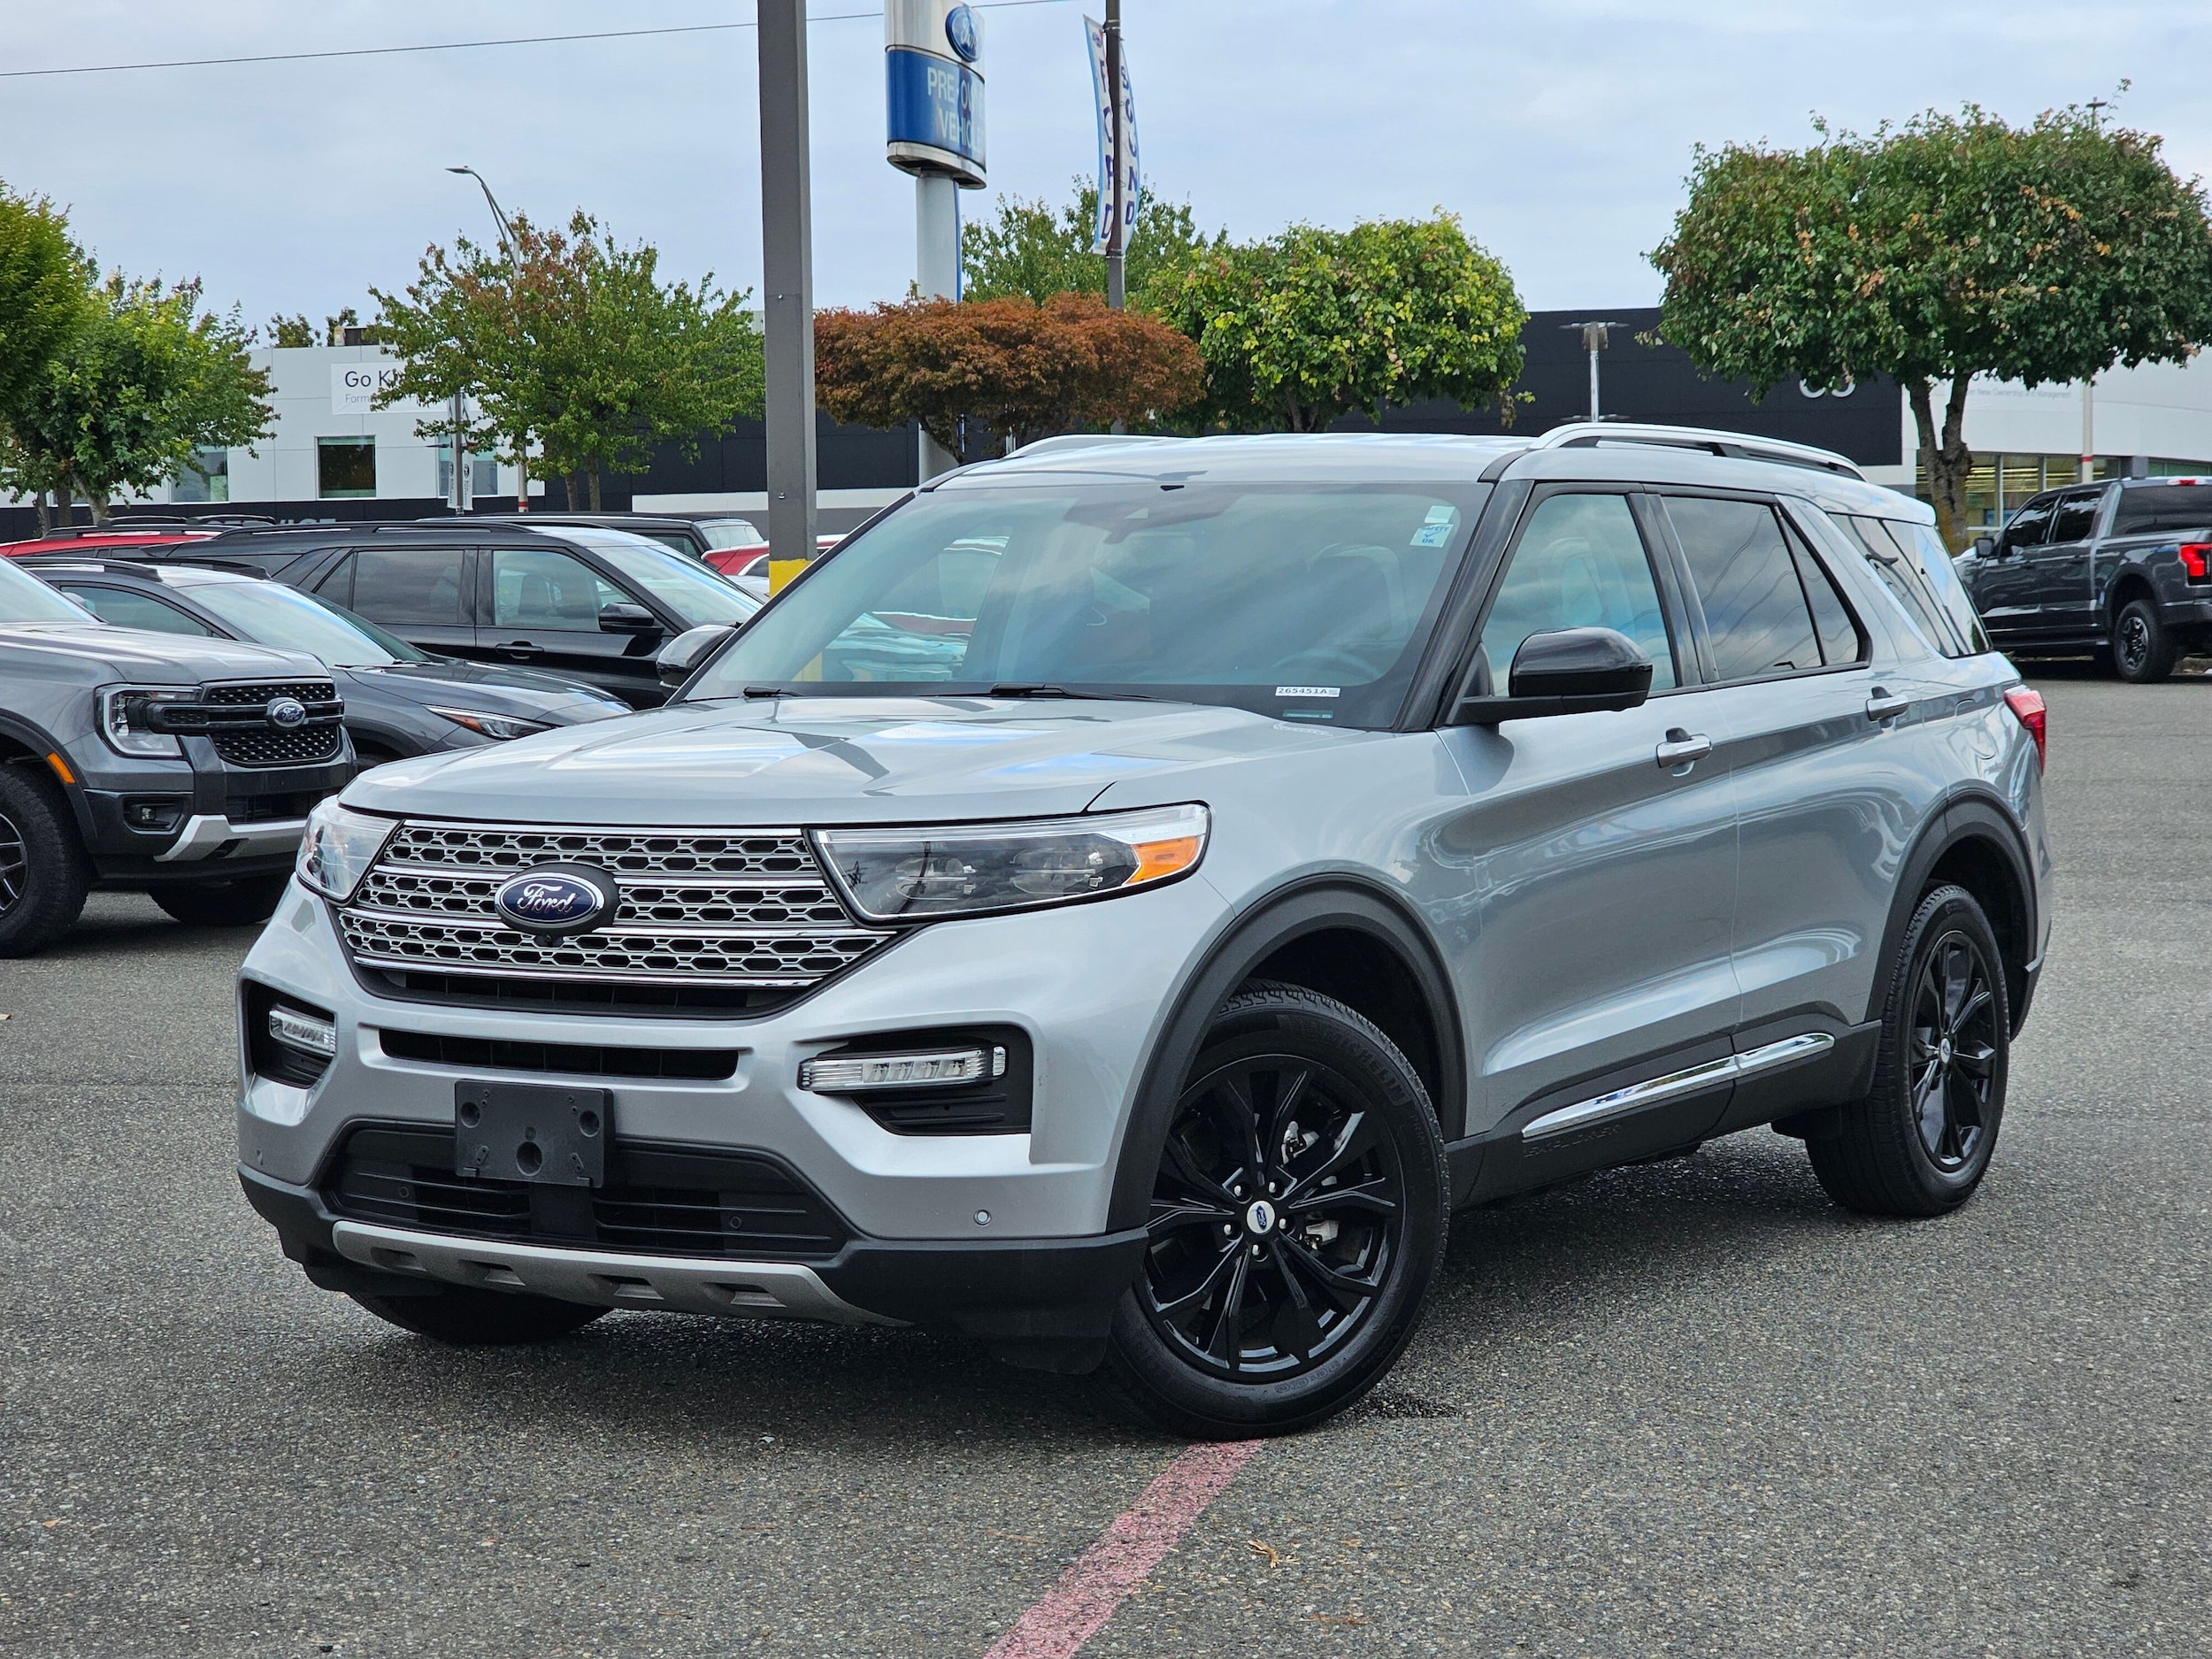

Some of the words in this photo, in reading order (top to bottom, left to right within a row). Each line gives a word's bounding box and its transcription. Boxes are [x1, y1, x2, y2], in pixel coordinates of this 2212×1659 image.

[927, 66, 956, 104] PRE
[344, 371, 372, 388] Go
[517, 883, 576, 914] Ford
